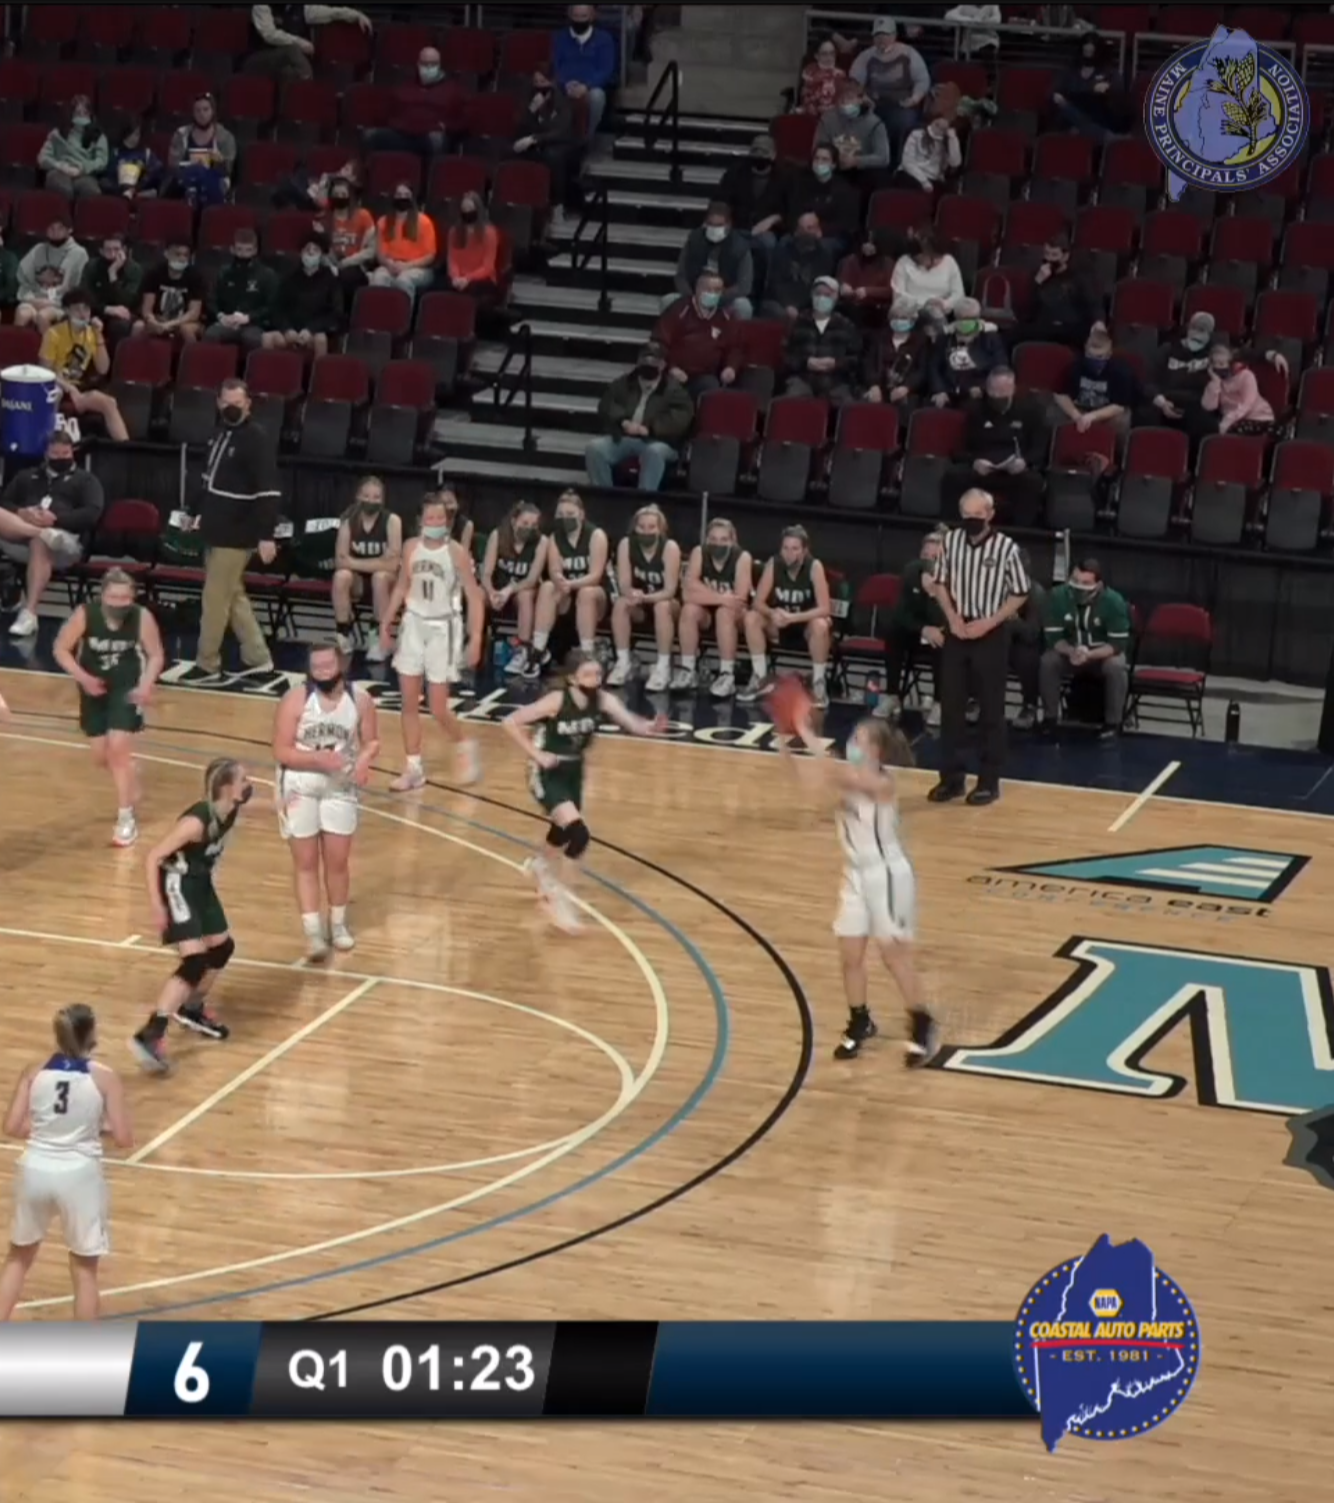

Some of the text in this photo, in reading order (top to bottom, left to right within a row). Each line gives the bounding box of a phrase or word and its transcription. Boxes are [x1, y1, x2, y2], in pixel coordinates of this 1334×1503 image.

[965, 874, 1272, 919] america east
[53, 1080, 71, 1115] 3
